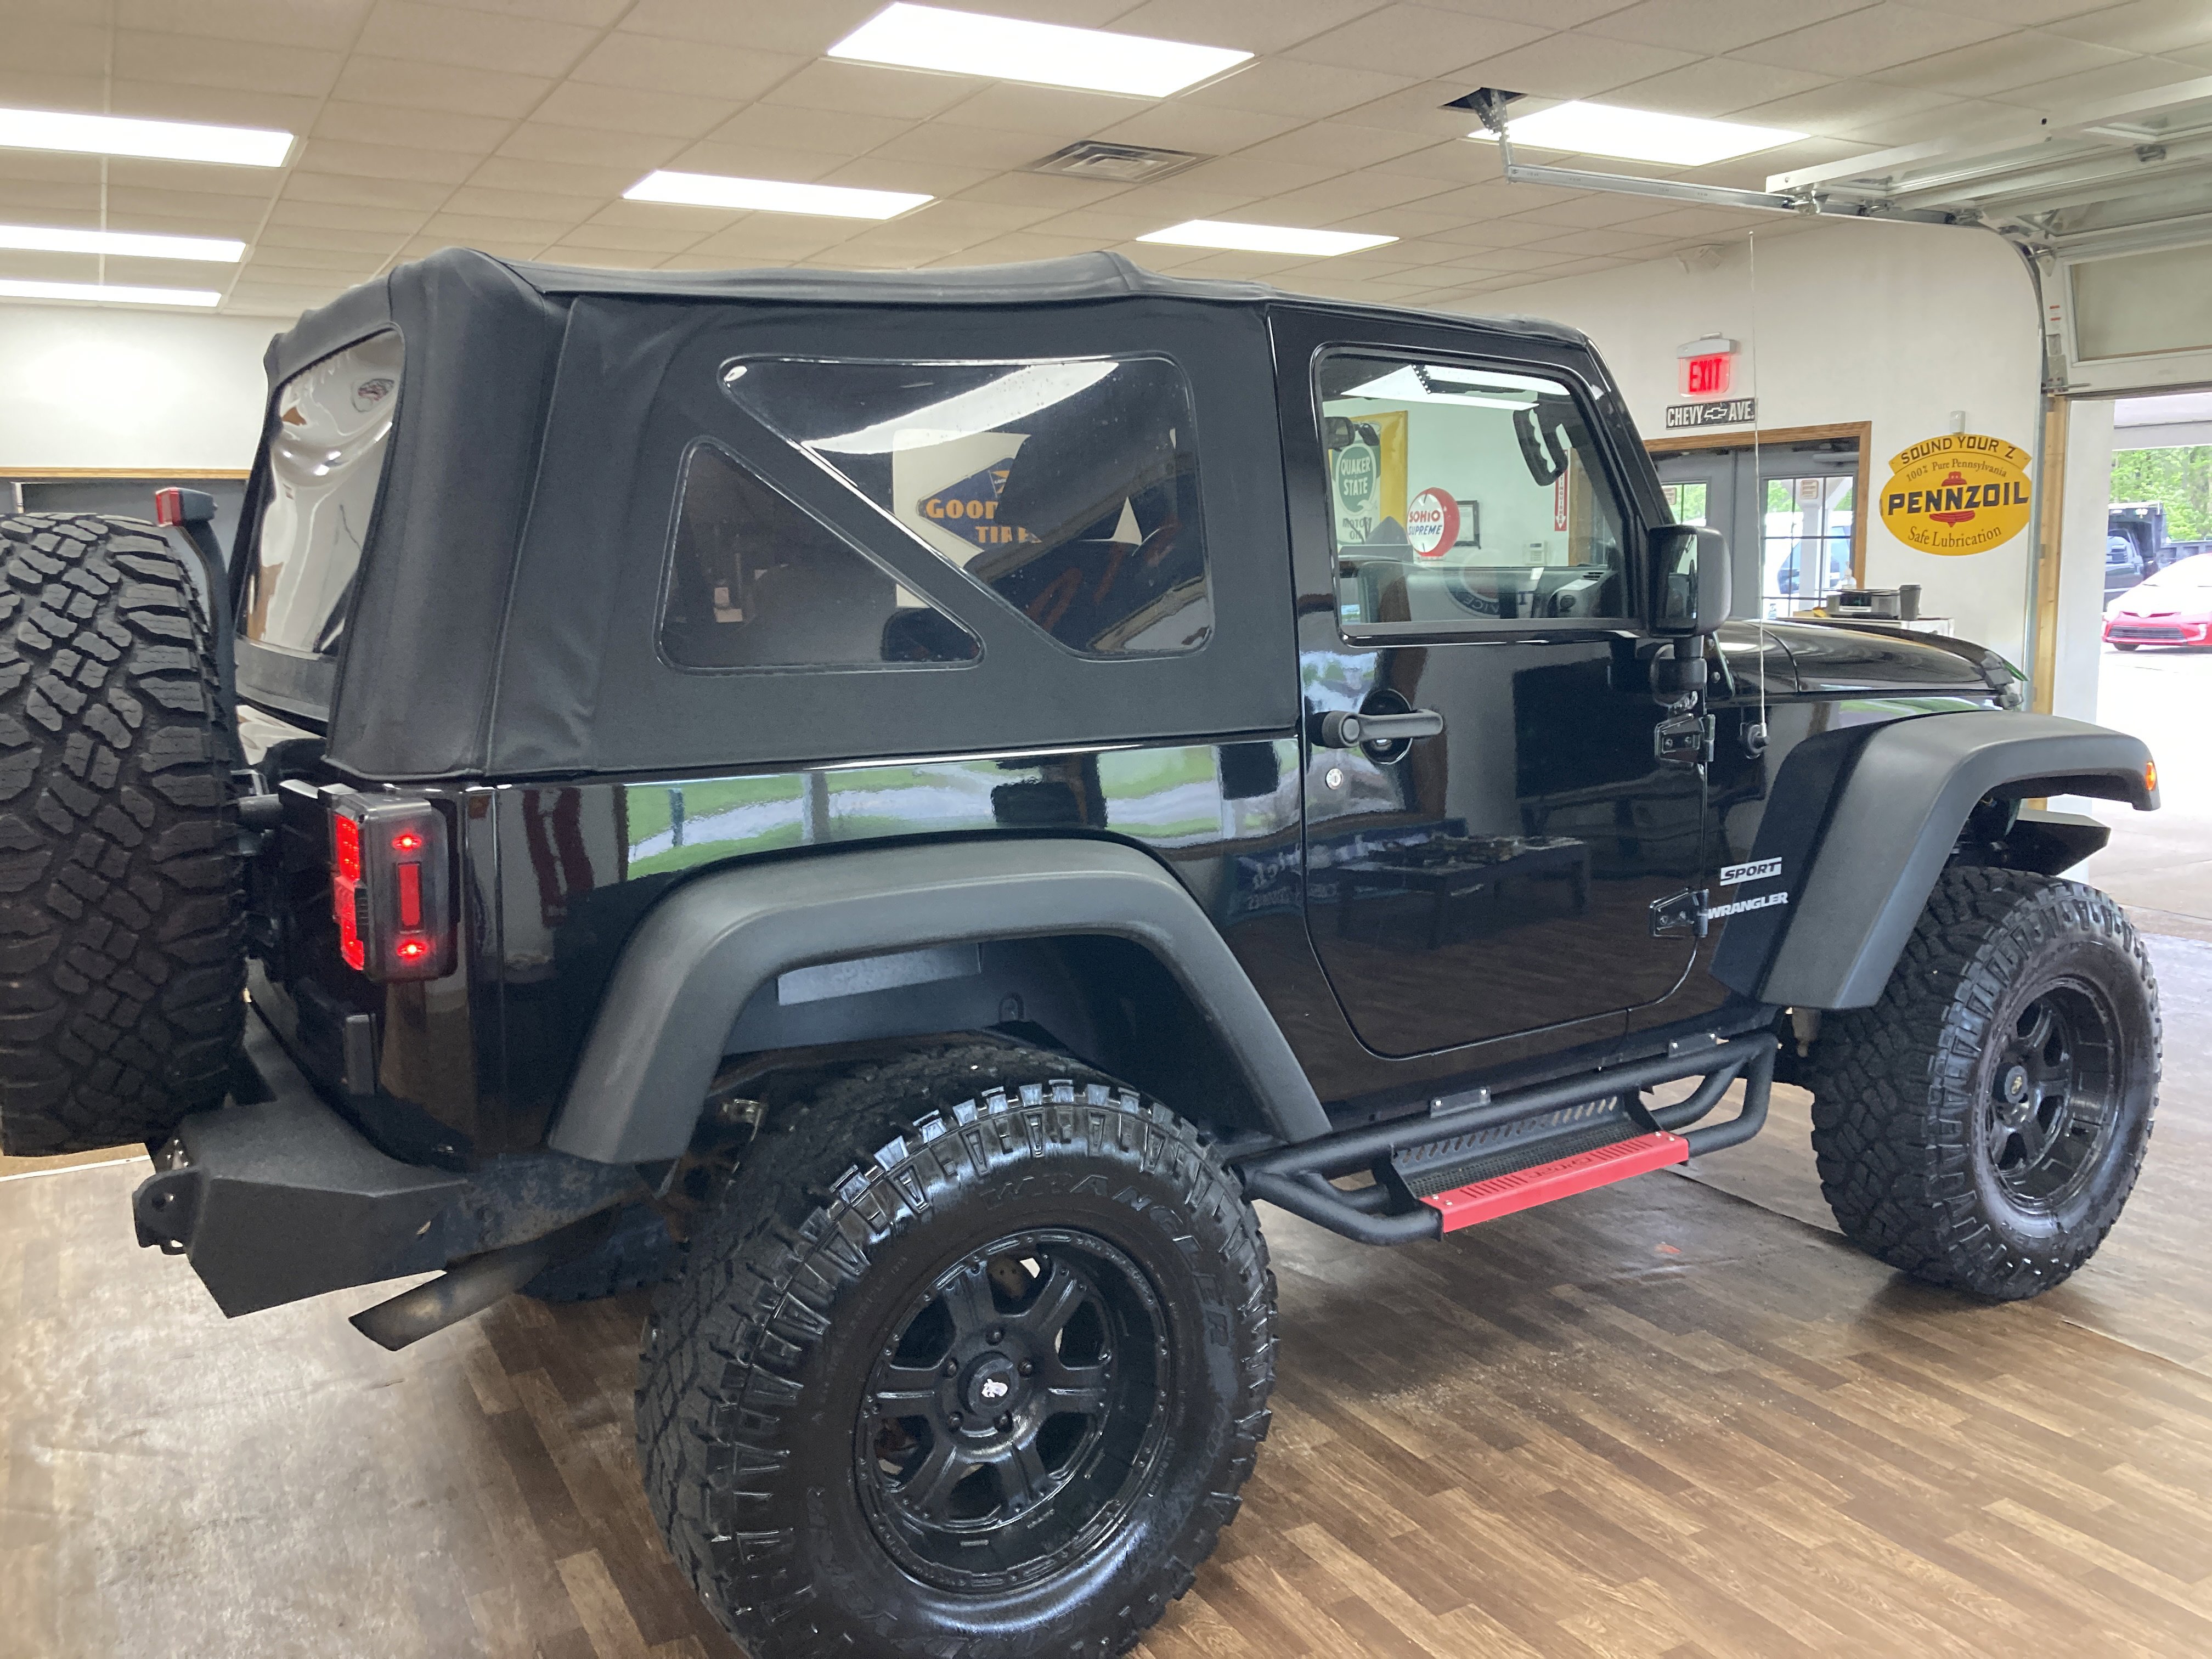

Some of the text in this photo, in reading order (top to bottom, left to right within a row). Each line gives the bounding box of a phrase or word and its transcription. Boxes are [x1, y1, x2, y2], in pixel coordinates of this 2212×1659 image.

[1690, 358, 1722, 392] EXIT
[1667, 401, 1754, 426] CHEVY AVE.
[1901, 436, 2018, 464] SOUND YOUR Z
[1341, 456, 1370, 476] QUAKER
[1906, 458, 2007, 482] 100% Pure Pennsylvania
[1344, 477, 1368, 496] STATE
[1888, 482, 2029, 515] PENNZOIL
[1409, 510, 1441, 523] SOHIO
[1408, 524, 1442, 536] SUPREME
[1908, 526, 2002, 548] Safe Lubrication
[1720, 861, 1782, 881] SPORT
[1708, 891, 1788, 919] WRANGLER
